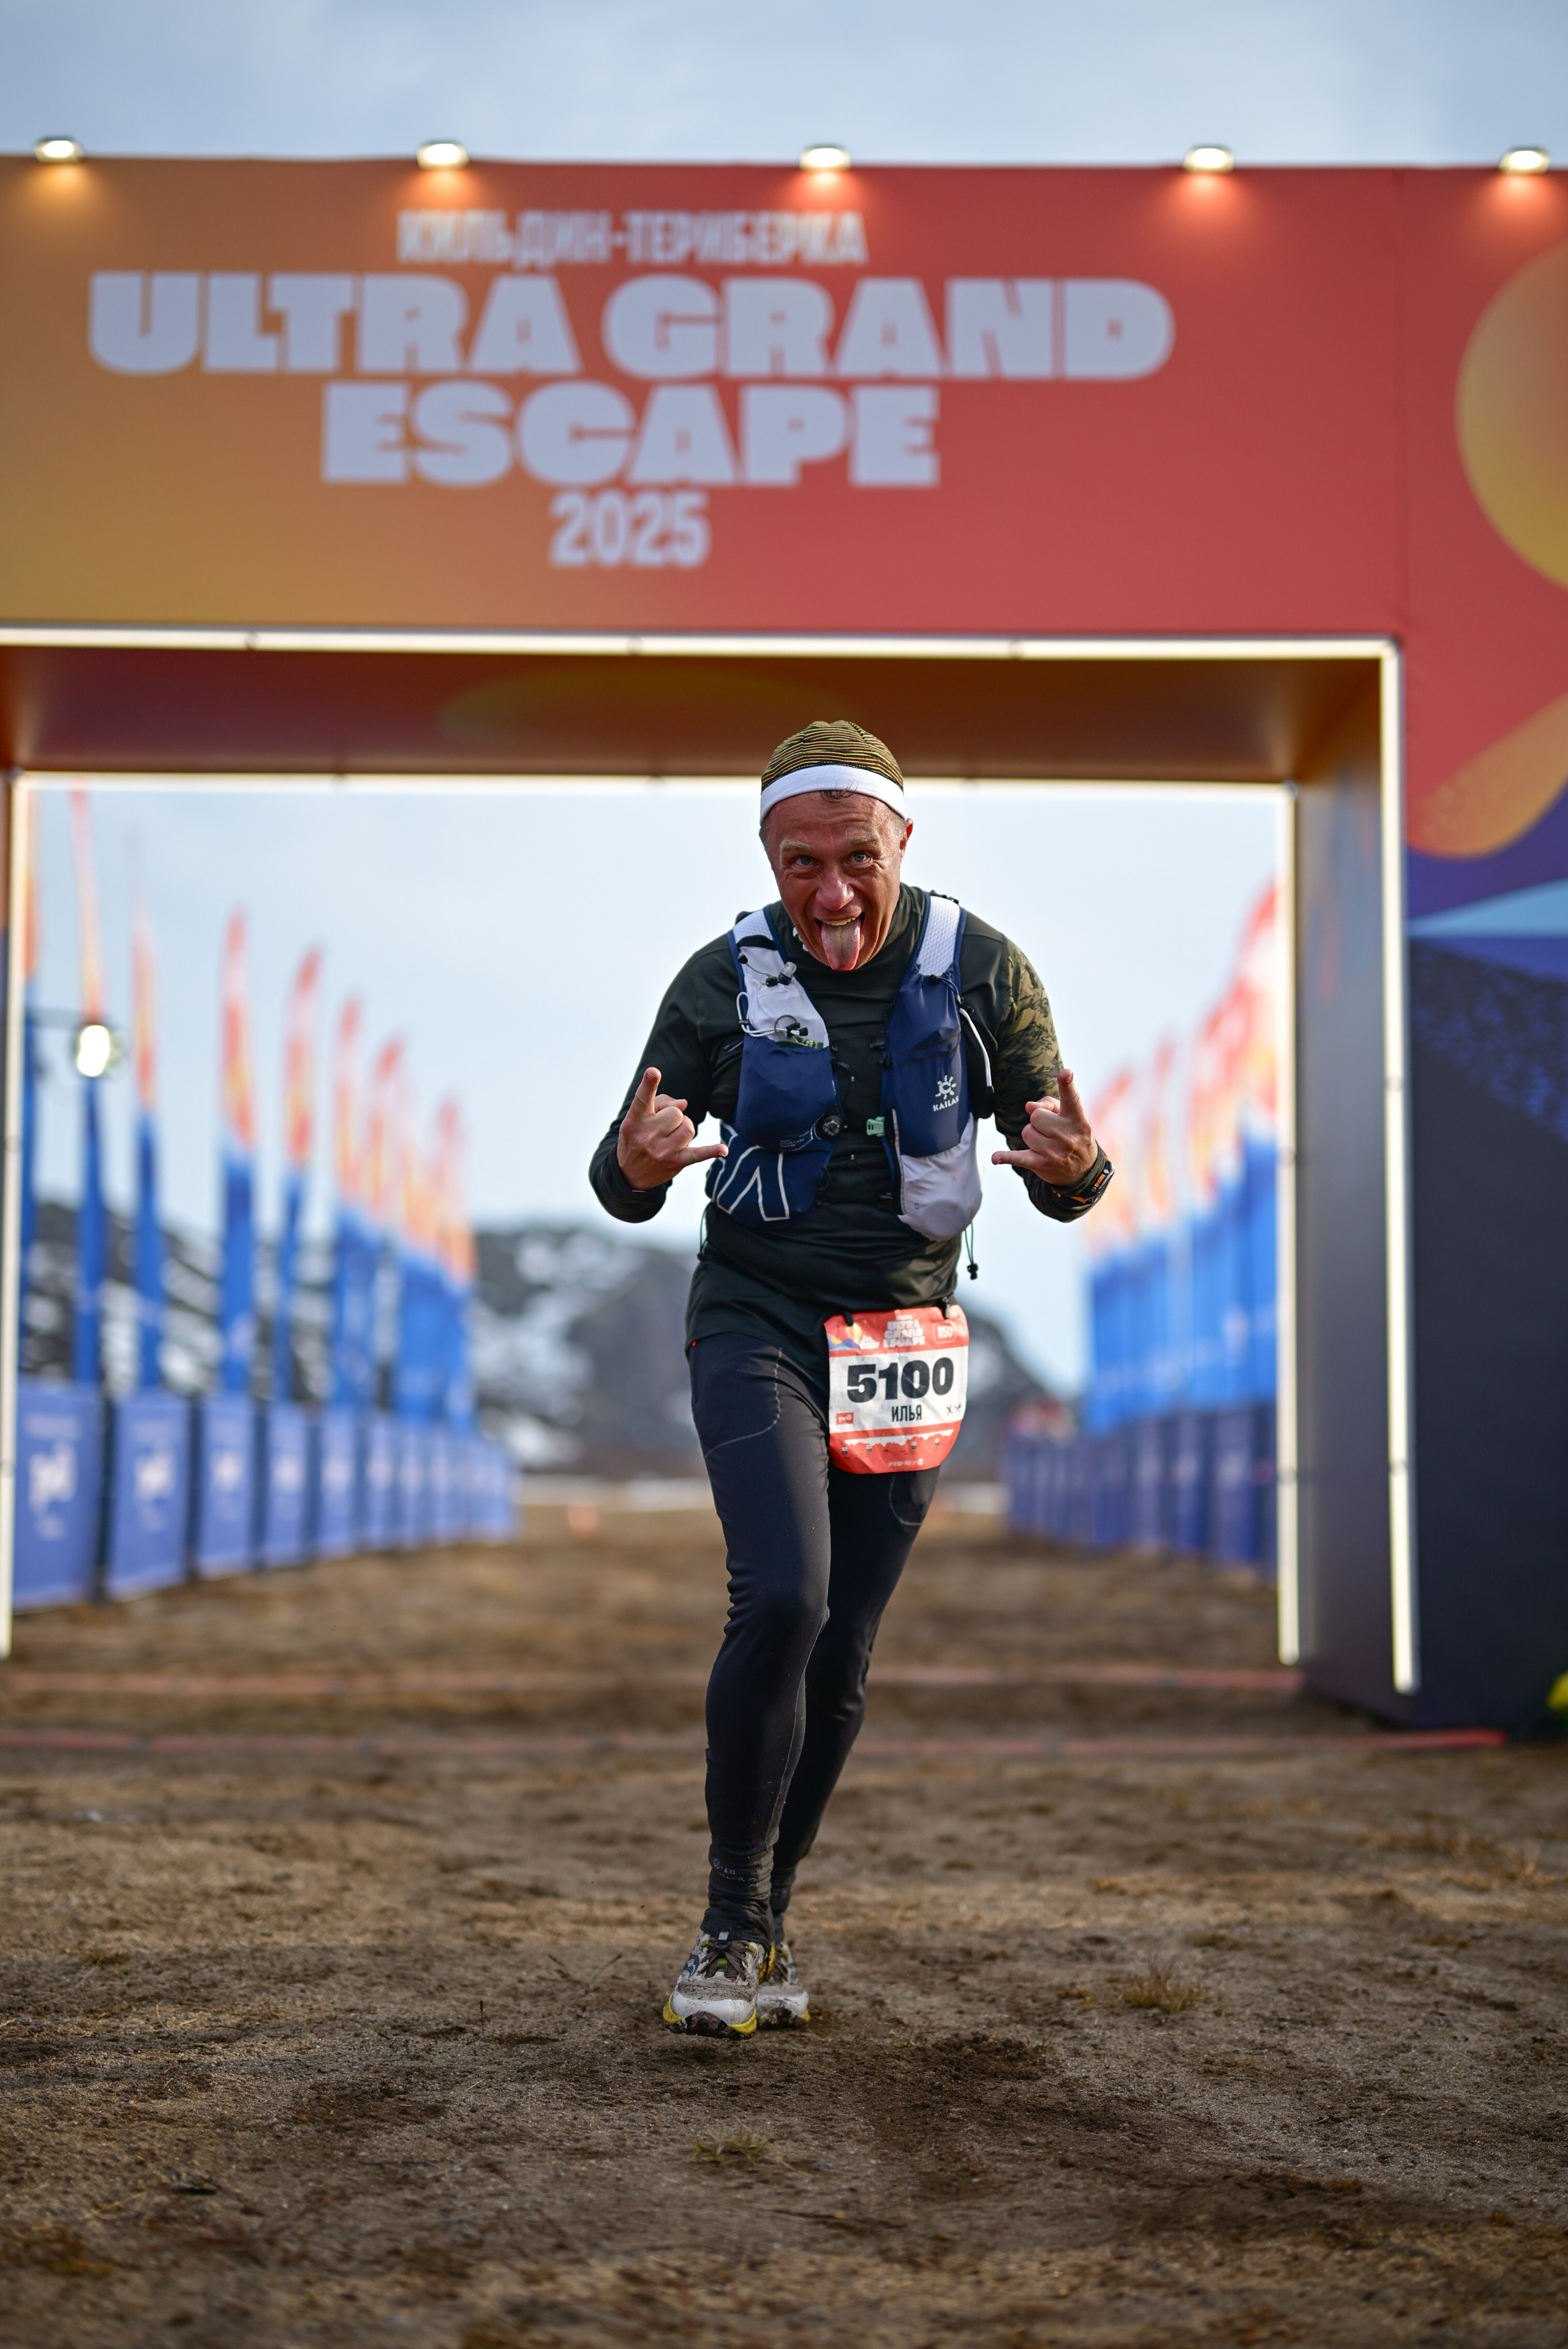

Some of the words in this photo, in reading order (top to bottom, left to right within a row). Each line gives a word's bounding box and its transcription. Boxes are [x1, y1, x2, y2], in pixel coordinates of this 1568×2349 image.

[88, 271, 582, 376] ULTRA
[601, 273, 1176, 382] GRAND
[321, 379, 940, 488] ESCAPE
[548, 490, 710, 569] 2025
[933, 1095, 959, 1111] KAILAS
[884, 1328, 924, 1340] GRAND
[887, 1319, 920, 1330] ULTRA
[883, 1336, 925, 1348] ESCAPE
[847, 1357, 954, 1403] 5100
[892, 1404, 922, 1423] ИЛЬЯ
